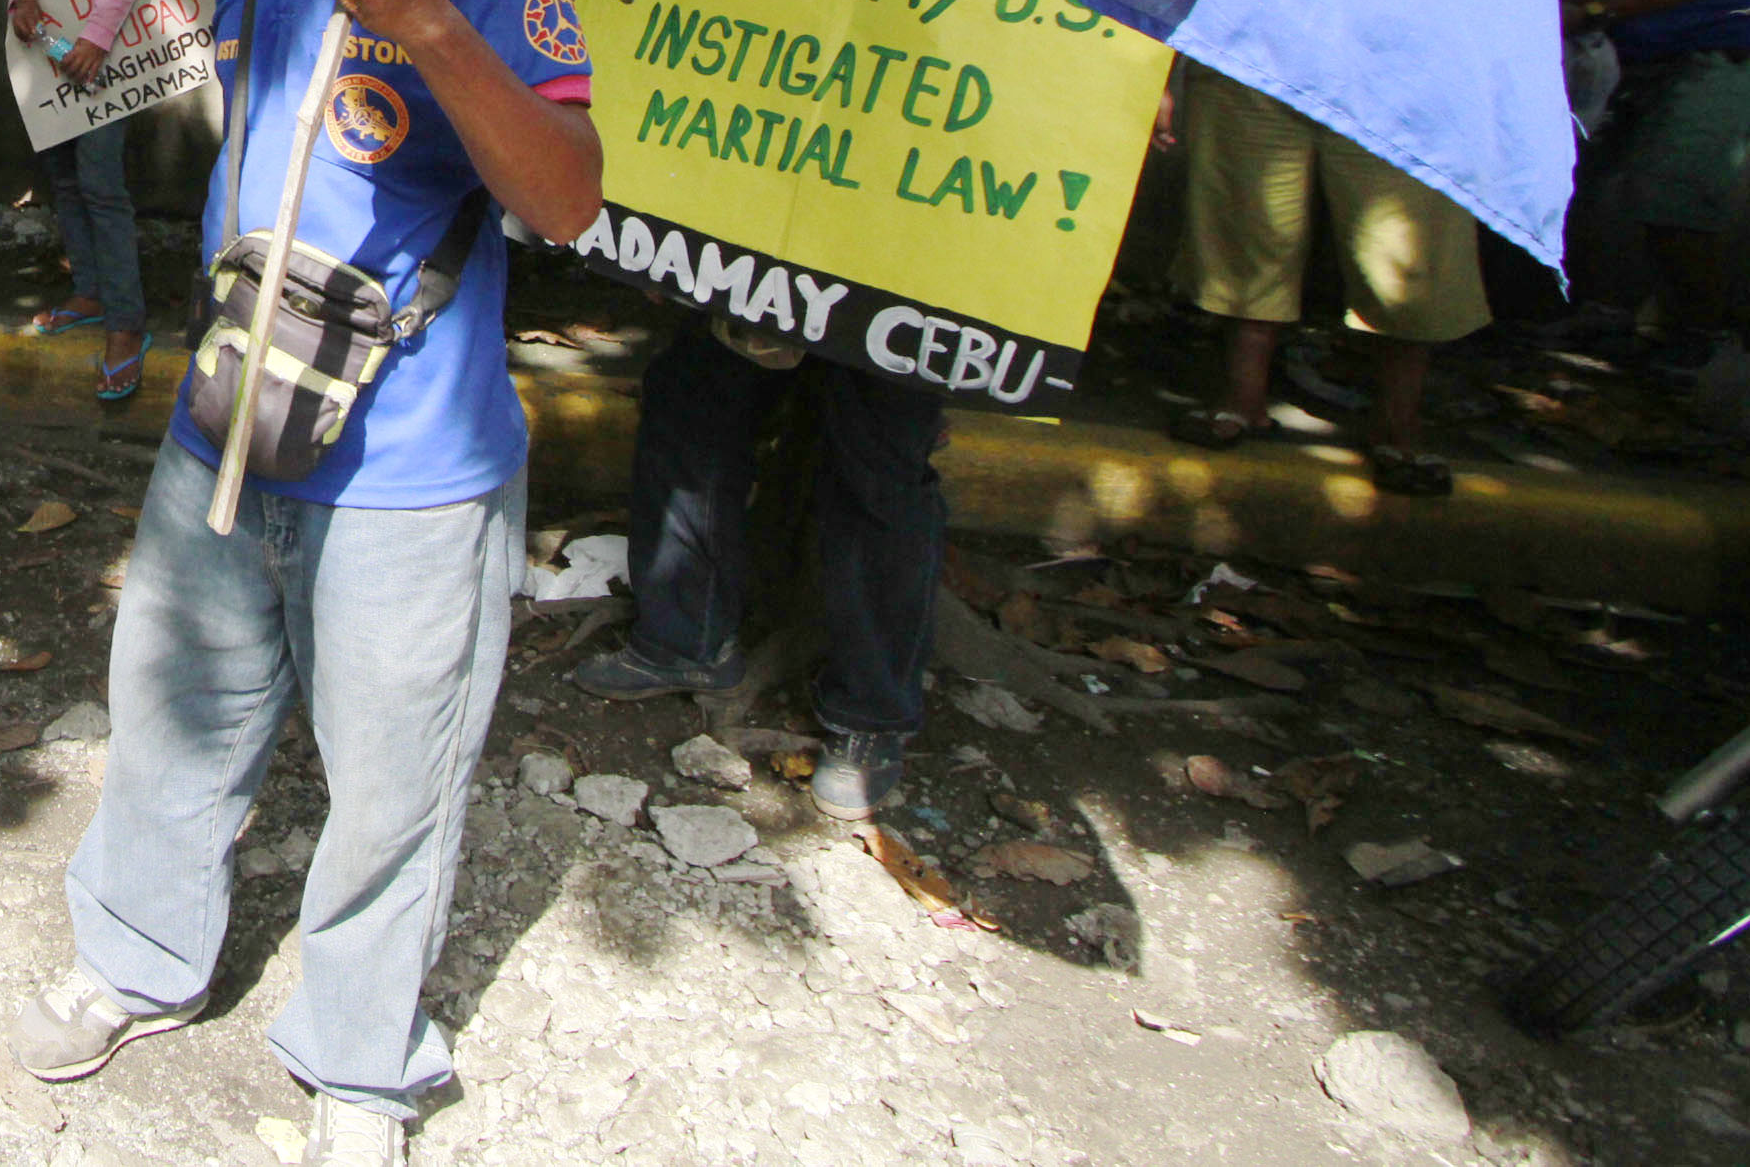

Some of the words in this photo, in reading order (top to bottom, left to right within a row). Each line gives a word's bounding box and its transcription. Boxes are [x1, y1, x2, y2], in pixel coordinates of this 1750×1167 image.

[85, 59, 210, 127] KADAMAY
[634, 2, 992, 133] INSTIGATED
[636, 89, 861, 190] MARTIAL
[896, 146, 1092, 233] LAW!
[544, 207, 850, 341] ADAMAY
